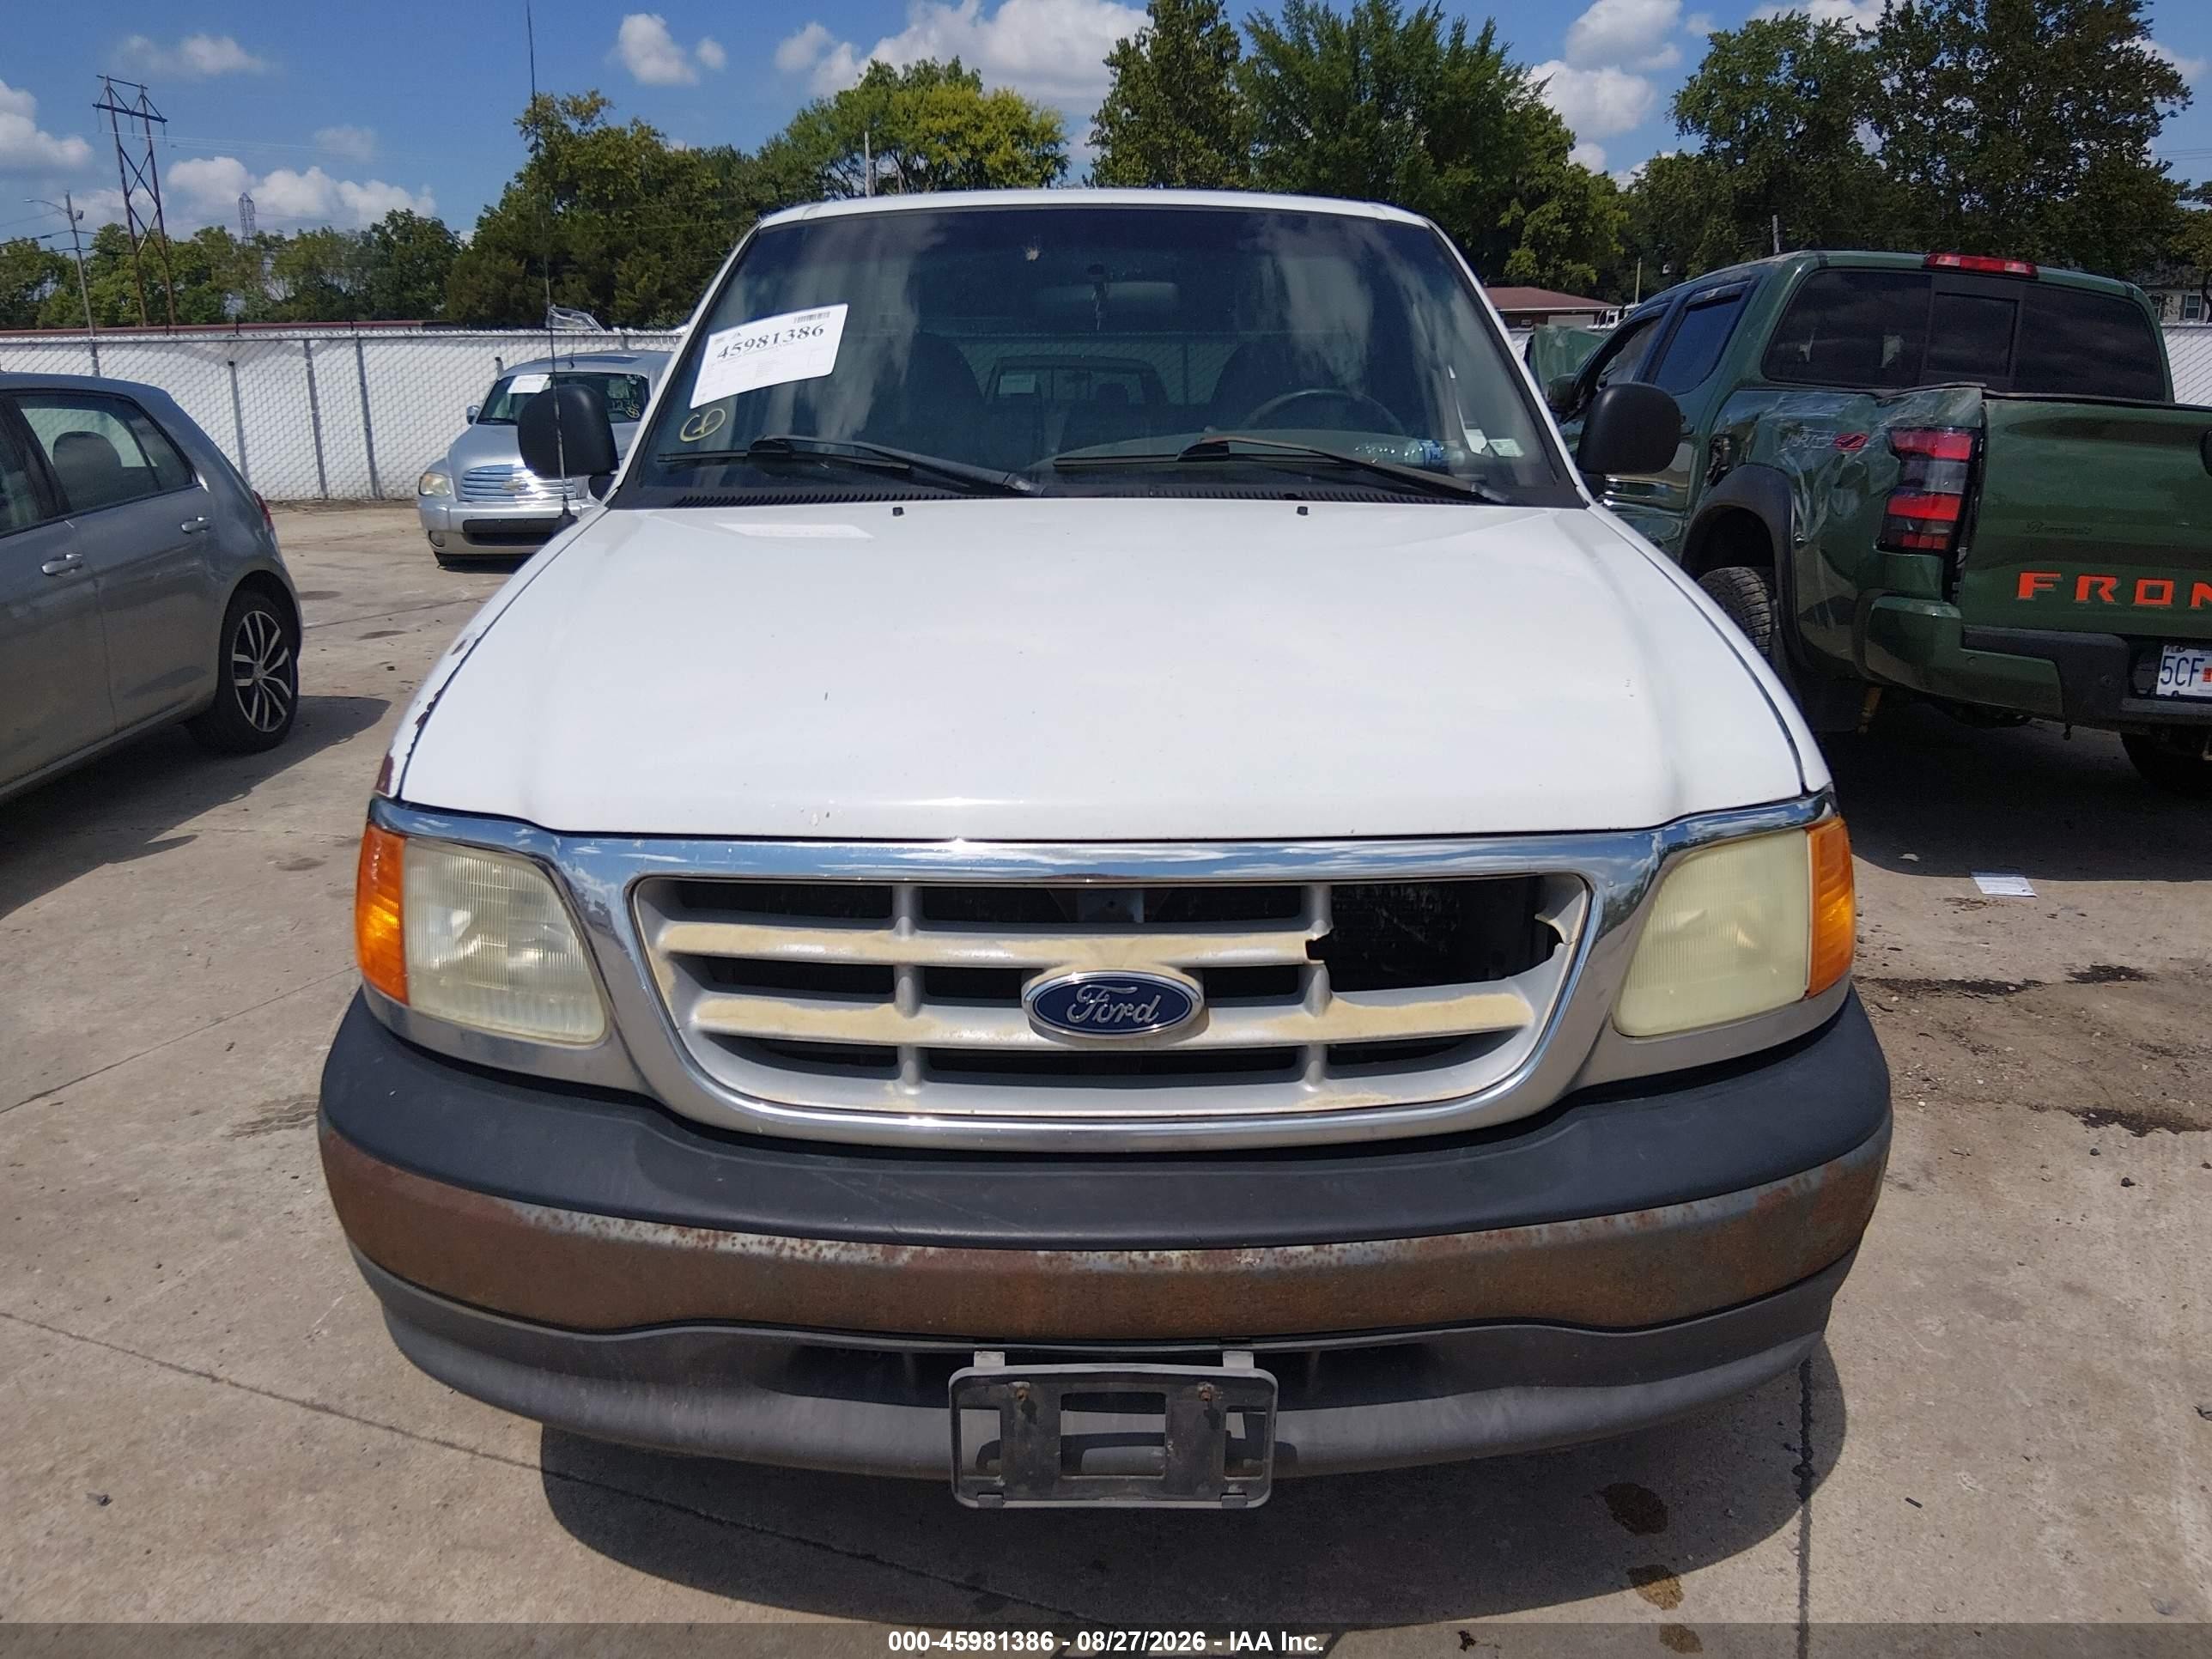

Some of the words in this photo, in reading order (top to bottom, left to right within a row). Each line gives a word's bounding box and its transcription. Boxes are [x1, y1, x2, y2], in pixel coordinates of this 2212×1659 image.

[716, 324, 824, 361] 45981386
[2160, 655, 2205, 688] 5CF
[1066, 983, 1162, 1024] Ford
